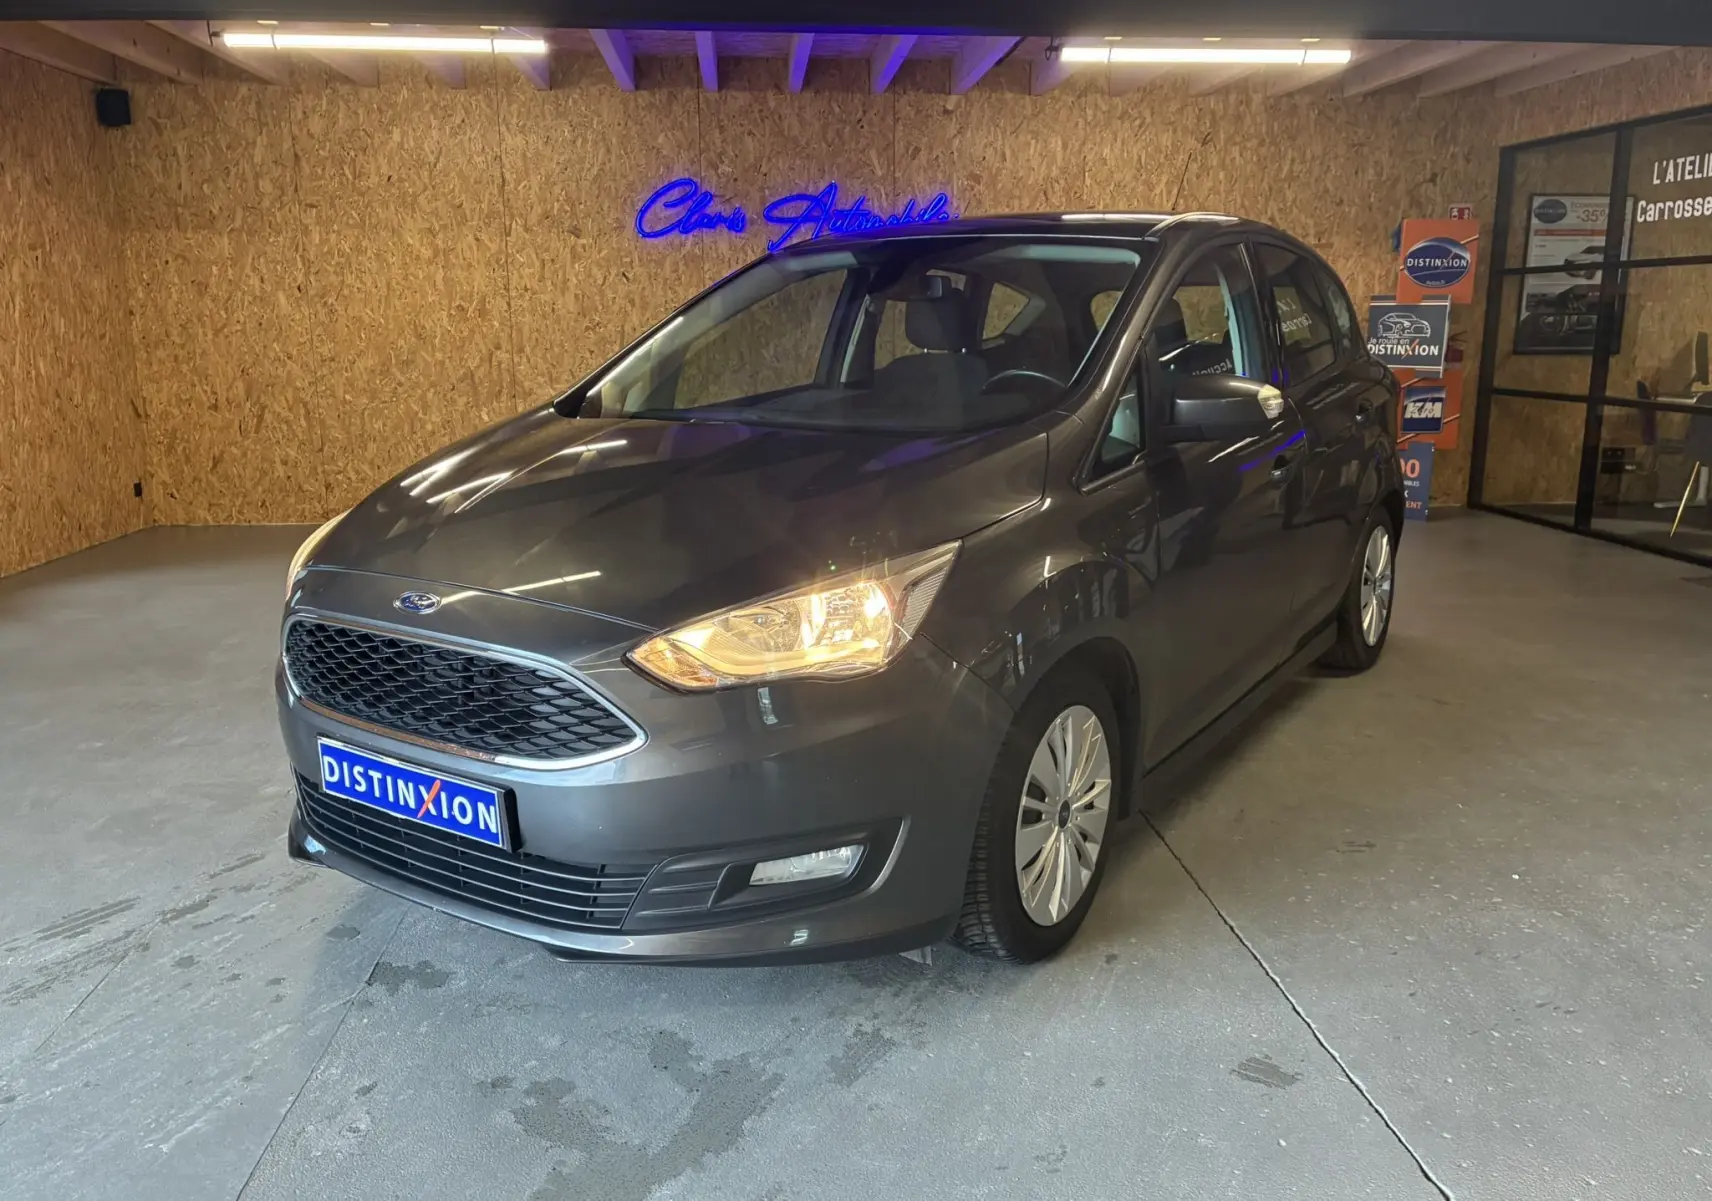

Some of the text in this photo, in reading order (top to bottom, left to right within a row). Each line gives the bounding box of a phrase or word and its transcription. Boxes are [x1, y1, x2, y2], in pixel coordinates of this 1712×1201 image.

[763, 180, 959, 251] Automobil
[1407, 257, 1467, 268] DISTINXION
[1367, 342, 1439, 357] DISTINXION
[322, 755, 498, 835] DISTINXION
